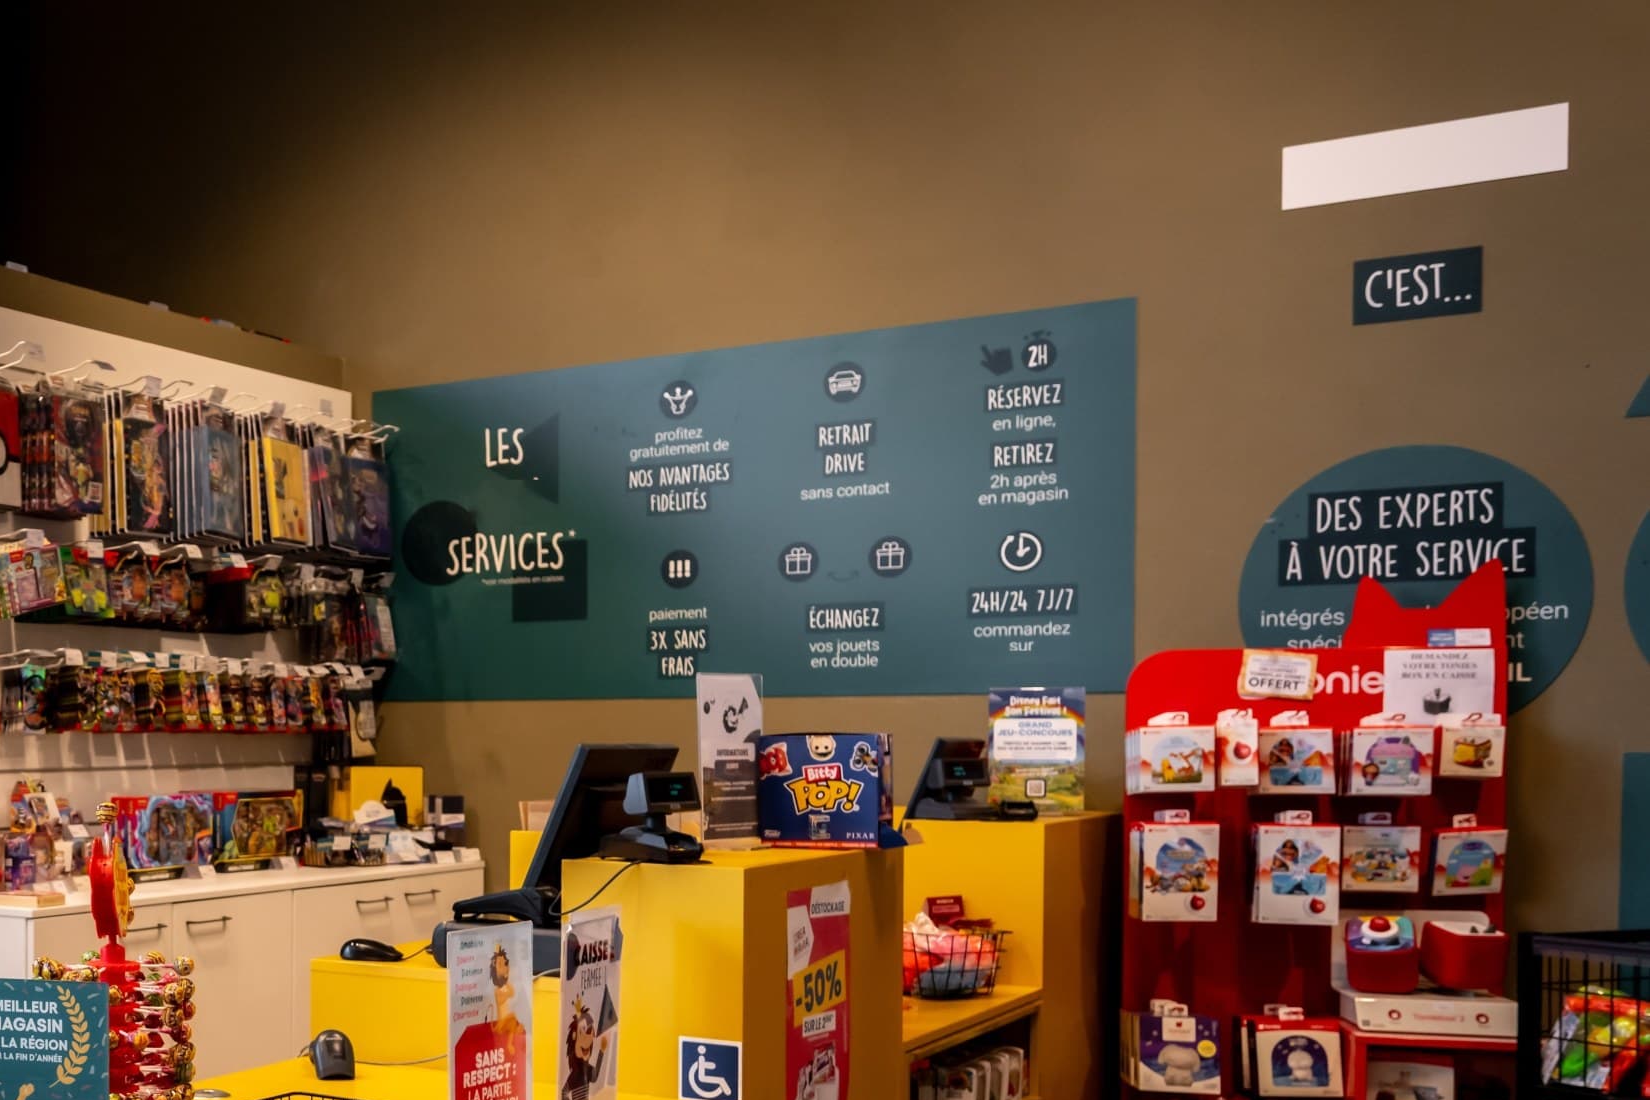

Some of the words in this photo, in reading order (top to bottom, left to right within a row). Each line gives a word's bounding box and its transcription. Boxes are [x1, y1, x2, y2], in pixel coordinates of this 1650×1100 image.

[1364, 262, 1472, 308] C'EST...
[1027, 344, 1048, 368] 2H
[988, 383, 1062, 411] RÉSERVEZ
[992, 418, 1012, 431] en
[1015, 415, 1057, 431] ligne,
[654, 427, 703, 444] profitez
[818, 422, 872, 447] RETRAIT
[484, 427, 524, 468] LES
[629, 441, 709, 462] gratuitement
[713, 438, 730, 452] de
[994, 443, 1054, 467] RETIREZ
[824, 452, 865, 475] DRIVE
[628, 469, 653, 489] NOS
[659, 462, 730, 487] AVANTAGES
[990, 474, 1010, 489] 2h
[1013, 470, 1057, 489] après
[650, 488, 707, 513] FIDÉLITÉS
[800, 486, 834, 500] sans
[837, 482, 890, 498] contact
[978, 493, 998, 506] en
[1001, 487, 1069, 506] magasin
[1315, 496, 1362, 533] DES
[1378, 488, 1495, 529] EXPERTS
[1286, 541, 1302, 582] À
[1319, 543, 1399, 580] VOTRE
[971, 590, 1028, 614] 24H/24
[1037, 588, 1074, 612] 7J/7
[649, 607, 708, 623] paiement
[809, 605, 880, 630] ÉCHANGEZ
[1260, 608, 1345, 630] intégrés
[650, 630, 668, 650] 3X
[673, 629, 706, 649] SANS
[973, 621, 1070, 638] commandez
[809, 640, 834, 653] vos
[836, 638, 880, 657] jouets
[1009, 640, 1034, 652] sur
[661, 656, 695, 677] FRAIS
[810, 655, 828, 668] en
[831, 653, 878, 668] double
[1248, 676, 1300, 691] OFFERT
[1314, 665, 1384, 694] onie
[1017, 721, 1052, 729] GRAND
[806, 766, 838, 781] Bitty
[786, 778, 863, 814] POP!
[796, 960, 842, 1013] -50%
[804, 1018, 816, 1033] SUR
[1, 1037, 18, 1049] LA
[20, 1035, 68, 1051] RÉGION
[3, 1052, 14, 1060] LA
[16, 1053, 28, 1061] FIN
[30, 1054, 63, 1063] D'ANNÉE
[475, 1048, 505, 1069] SANS
[463, 1062, 511, 1089] RESPECT
[482, 1081, 512, 1100] PARTIE
